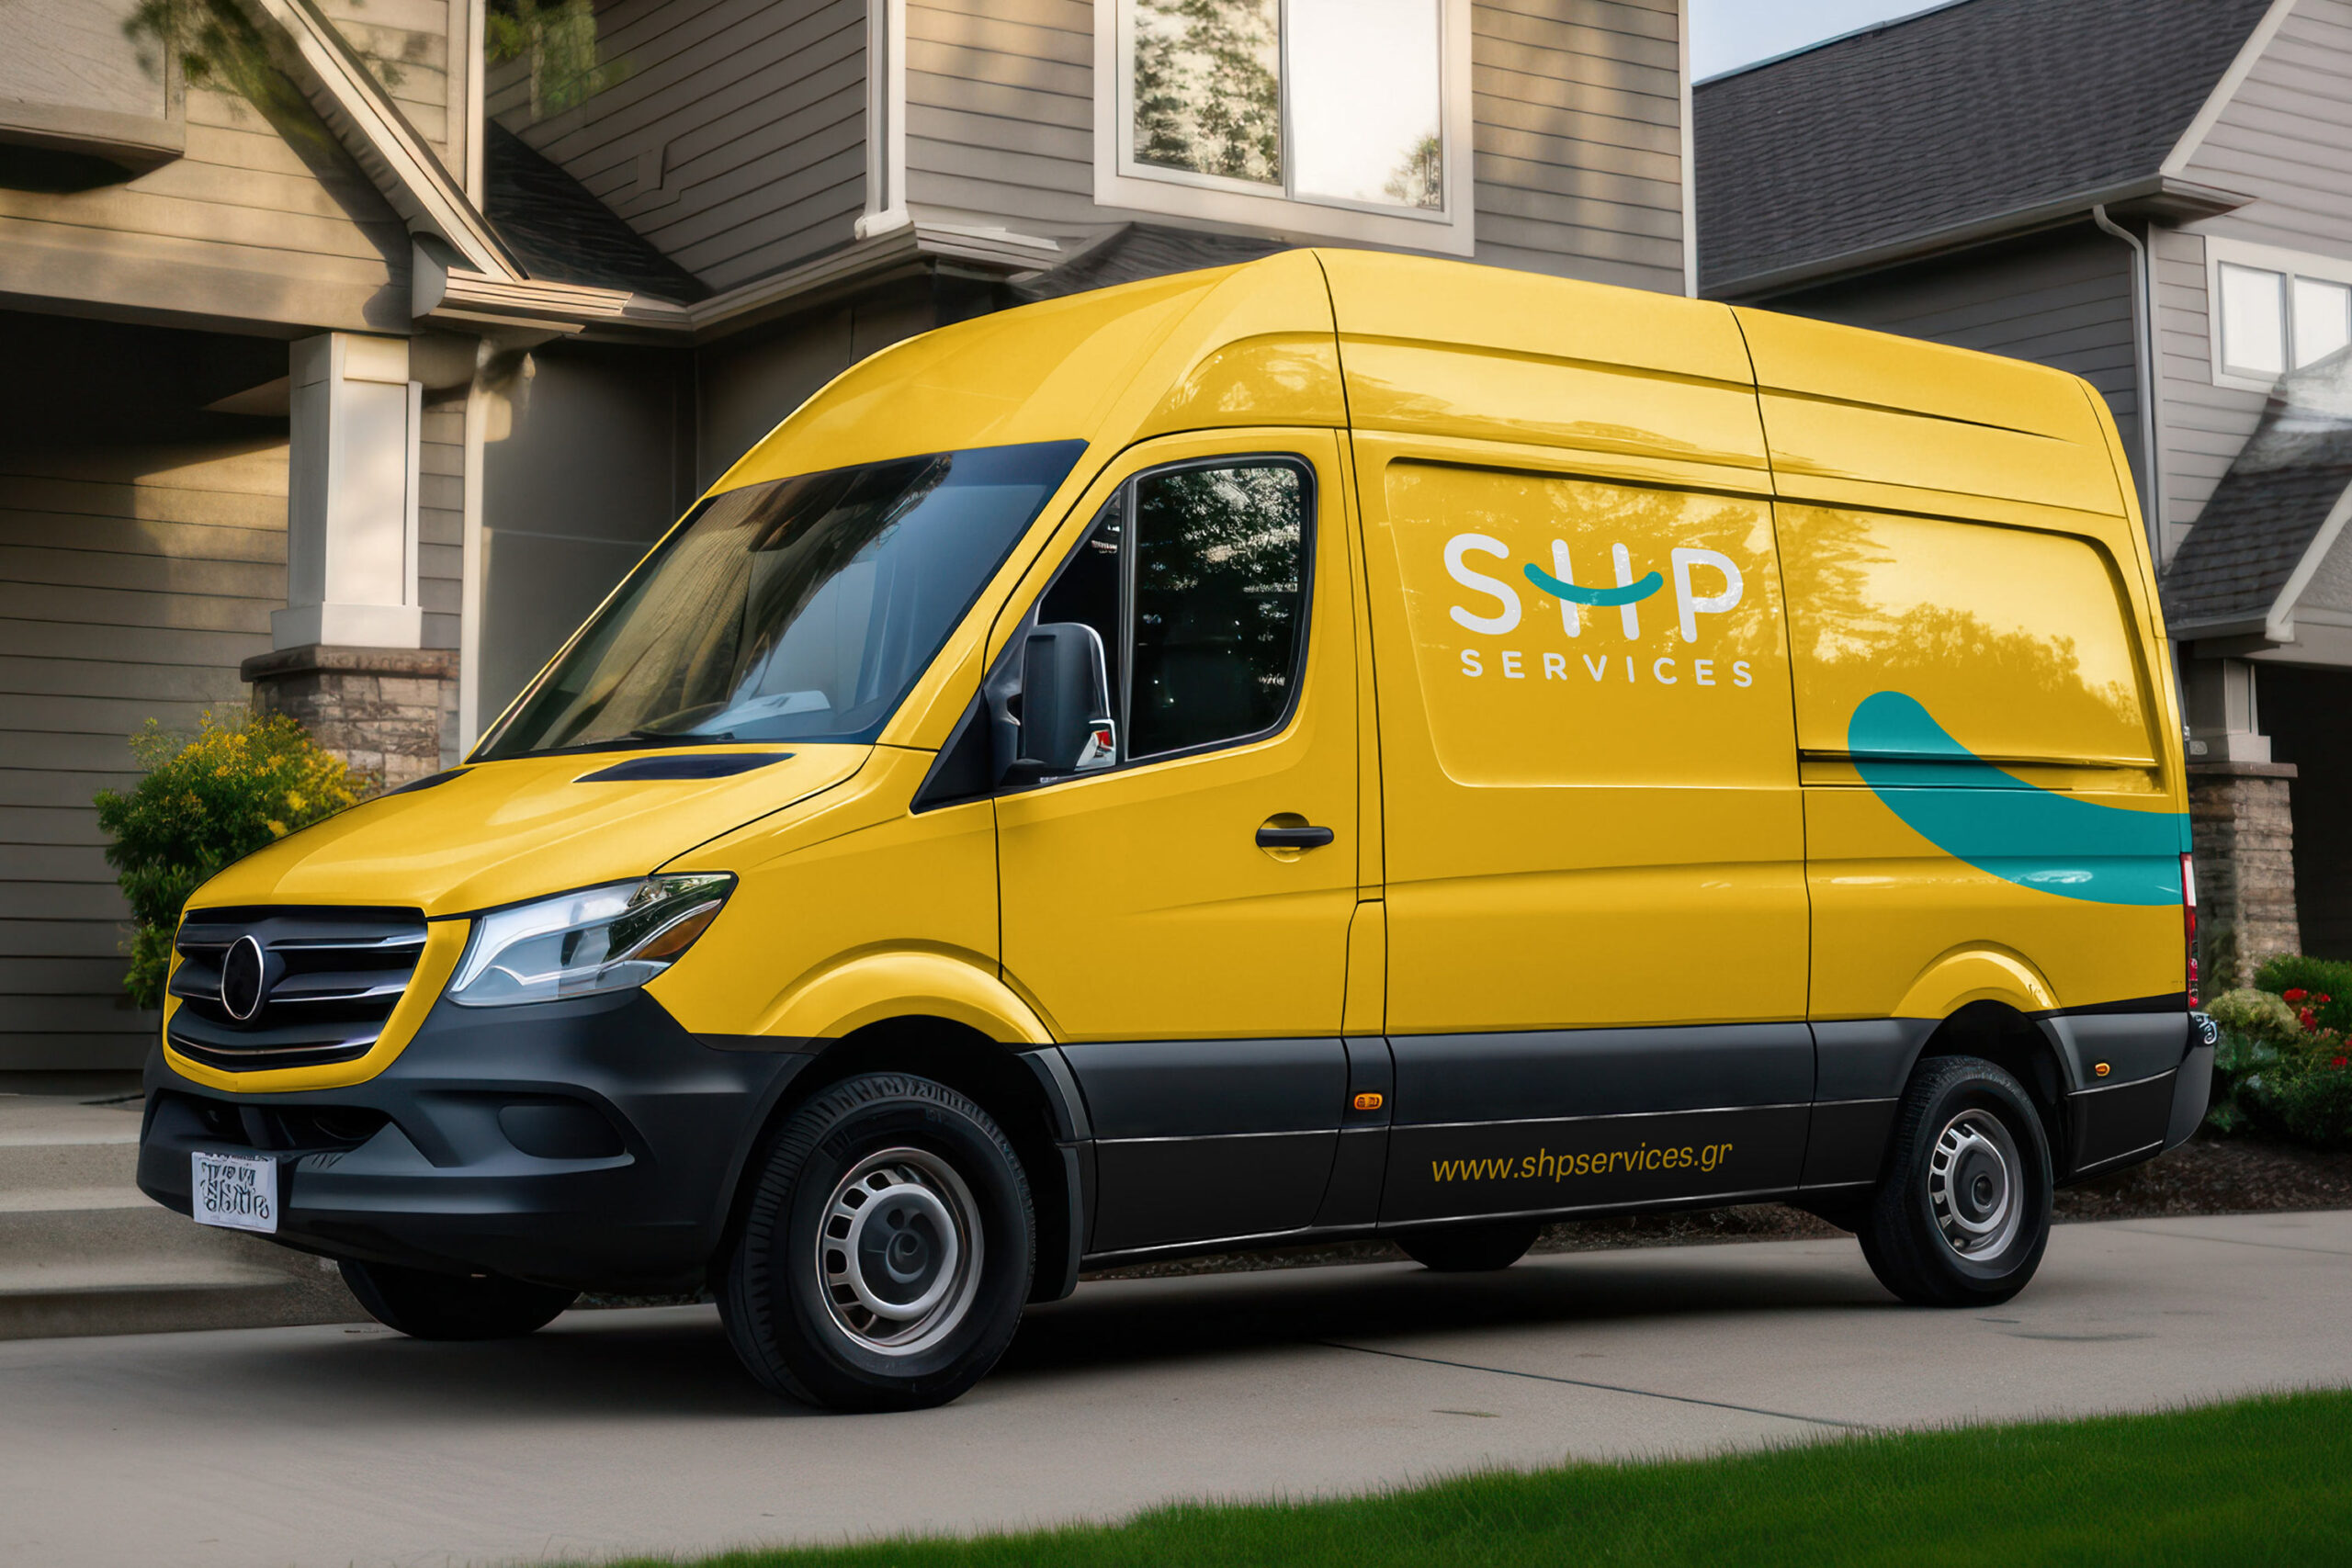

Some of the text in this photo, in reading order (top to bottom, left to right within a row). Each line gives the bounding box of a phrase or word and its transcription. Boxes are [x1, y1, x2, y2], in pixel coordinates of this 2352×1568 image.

[1443, 533, 1744, 643] SHP
[1460, 649, 1753, 687] SERVICES
[1431, 1142, 1733, 1182] www.shpservices.gr
